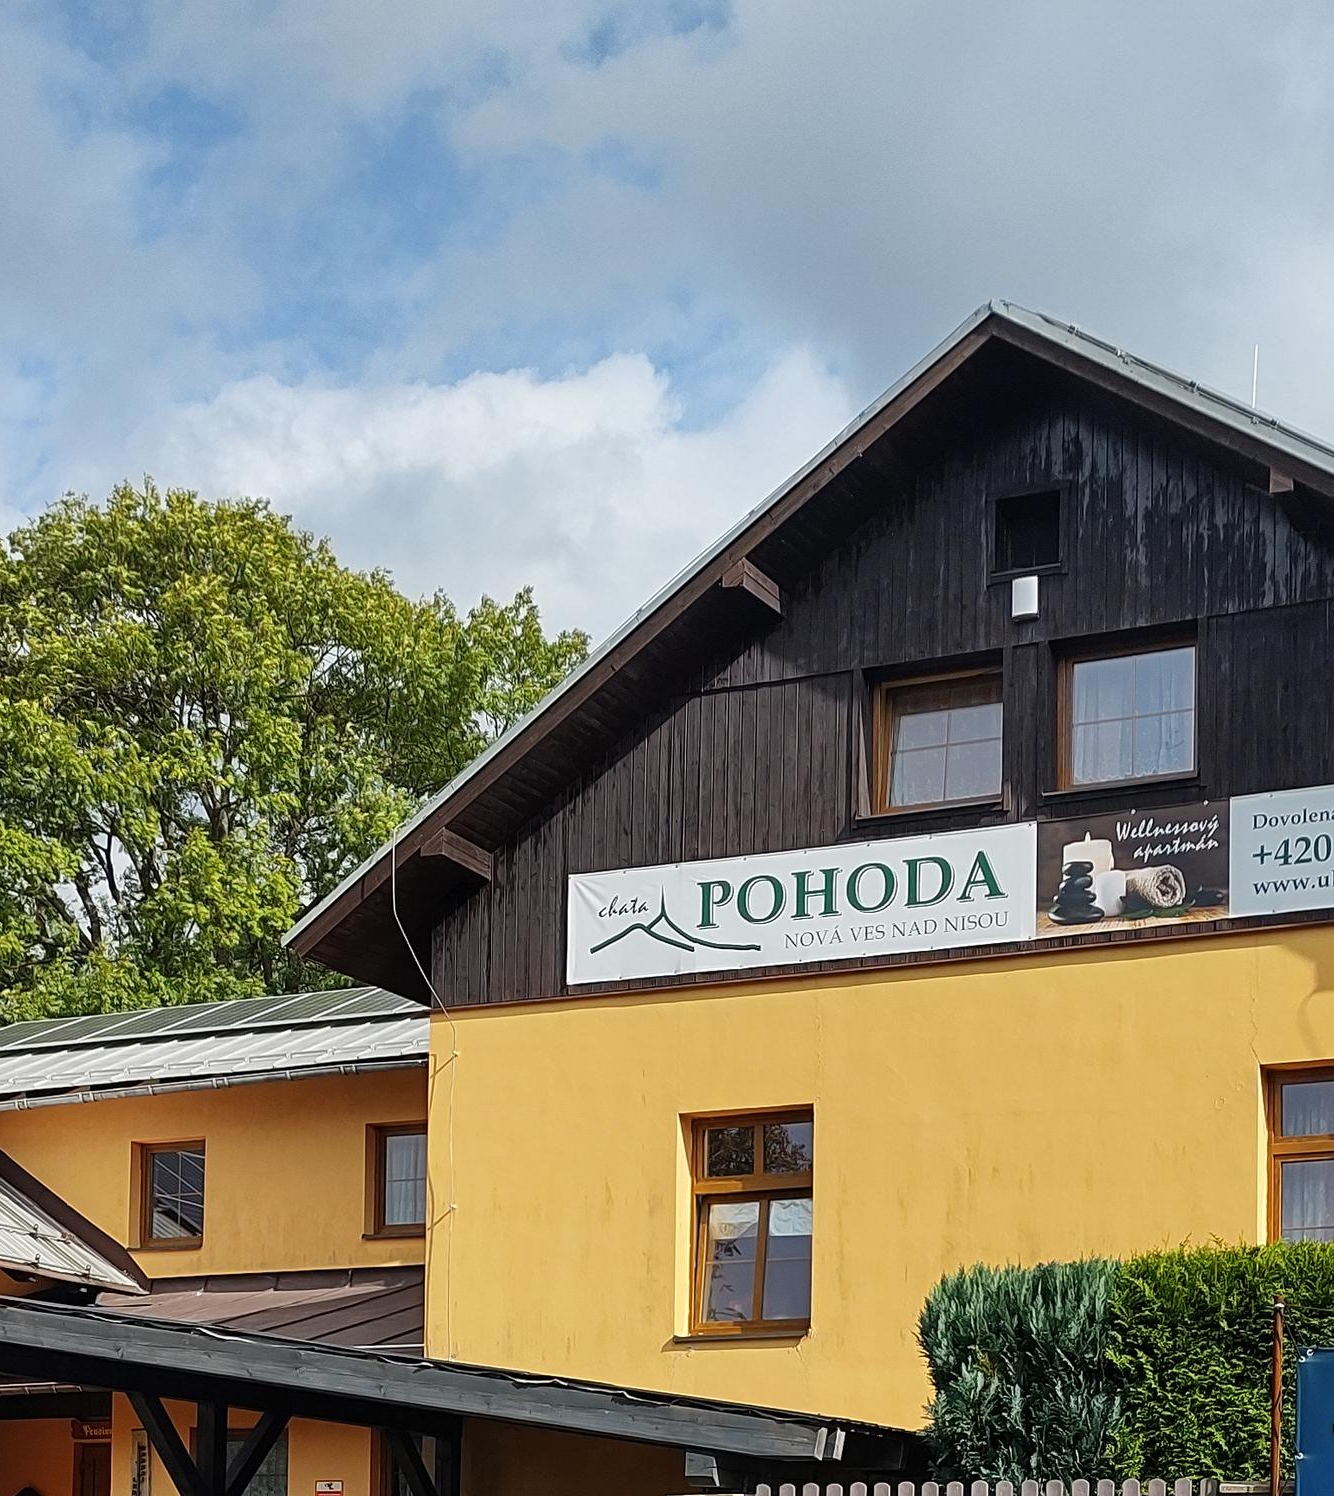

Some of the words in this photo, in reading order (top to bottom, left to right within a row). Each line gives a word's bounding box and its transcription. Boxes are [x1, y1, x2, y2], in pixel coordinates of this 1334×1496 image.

[1116, 815, 1220, 842] Wellnessový
[1133, 836, 1219, 864] apartmán
[1253, 833, 1333, 867] +420
[696, 850, 1008, 930] POHODA
[598, 896, 649, 918] chata
[784, 924, 845, 949] NOVÁ
[851, 922, 886, 942] VES
[892, 918, 939, 938] NAD
[943, 910, 1010, 934] NISOU
